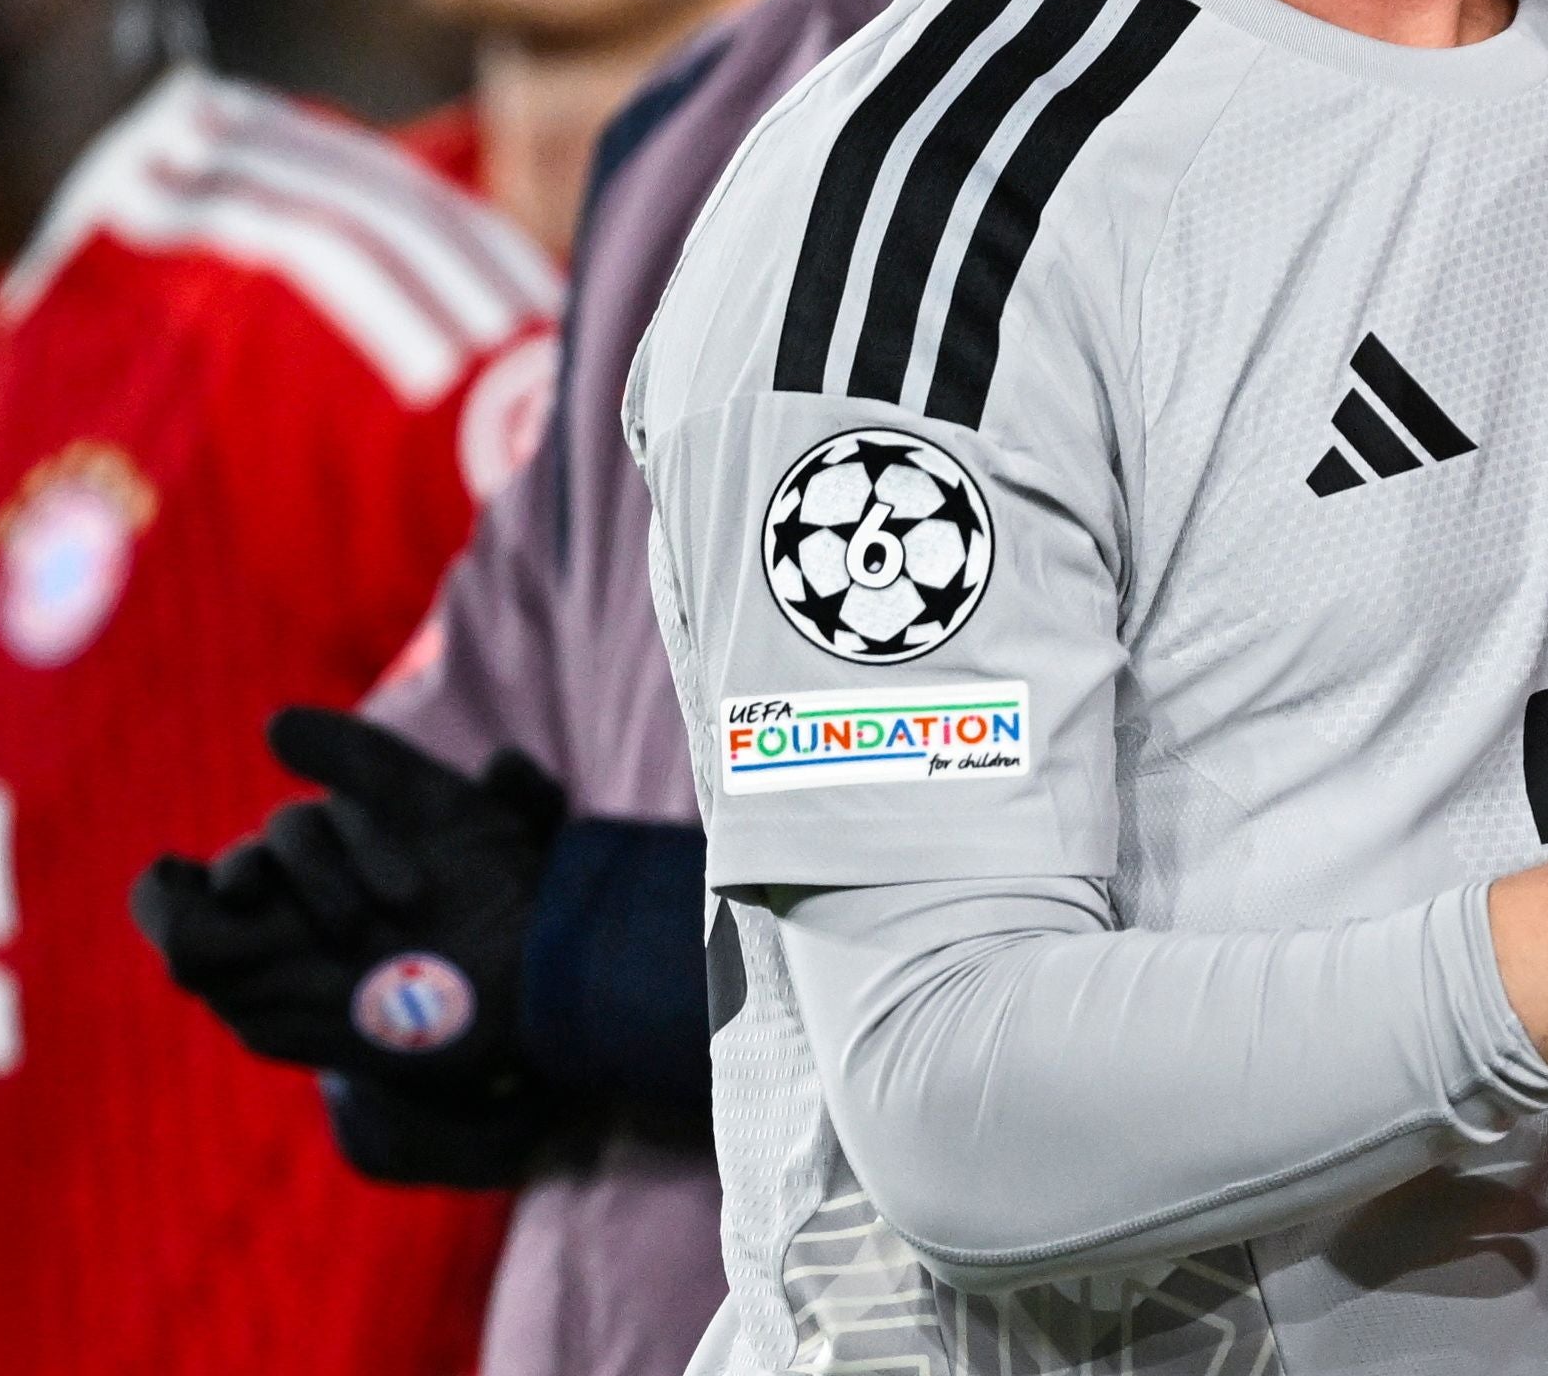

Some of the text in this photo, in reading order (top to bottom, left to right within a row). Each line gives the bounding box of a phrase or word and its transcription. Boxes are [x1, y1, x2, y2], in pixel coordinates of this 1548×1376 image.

[845, 501, 906, 590] 6
[728, 700, 794, 725] UEFA
[728, 712, 1022, 761] FOUNDATION
[926, 753, 1022, 777] for children
